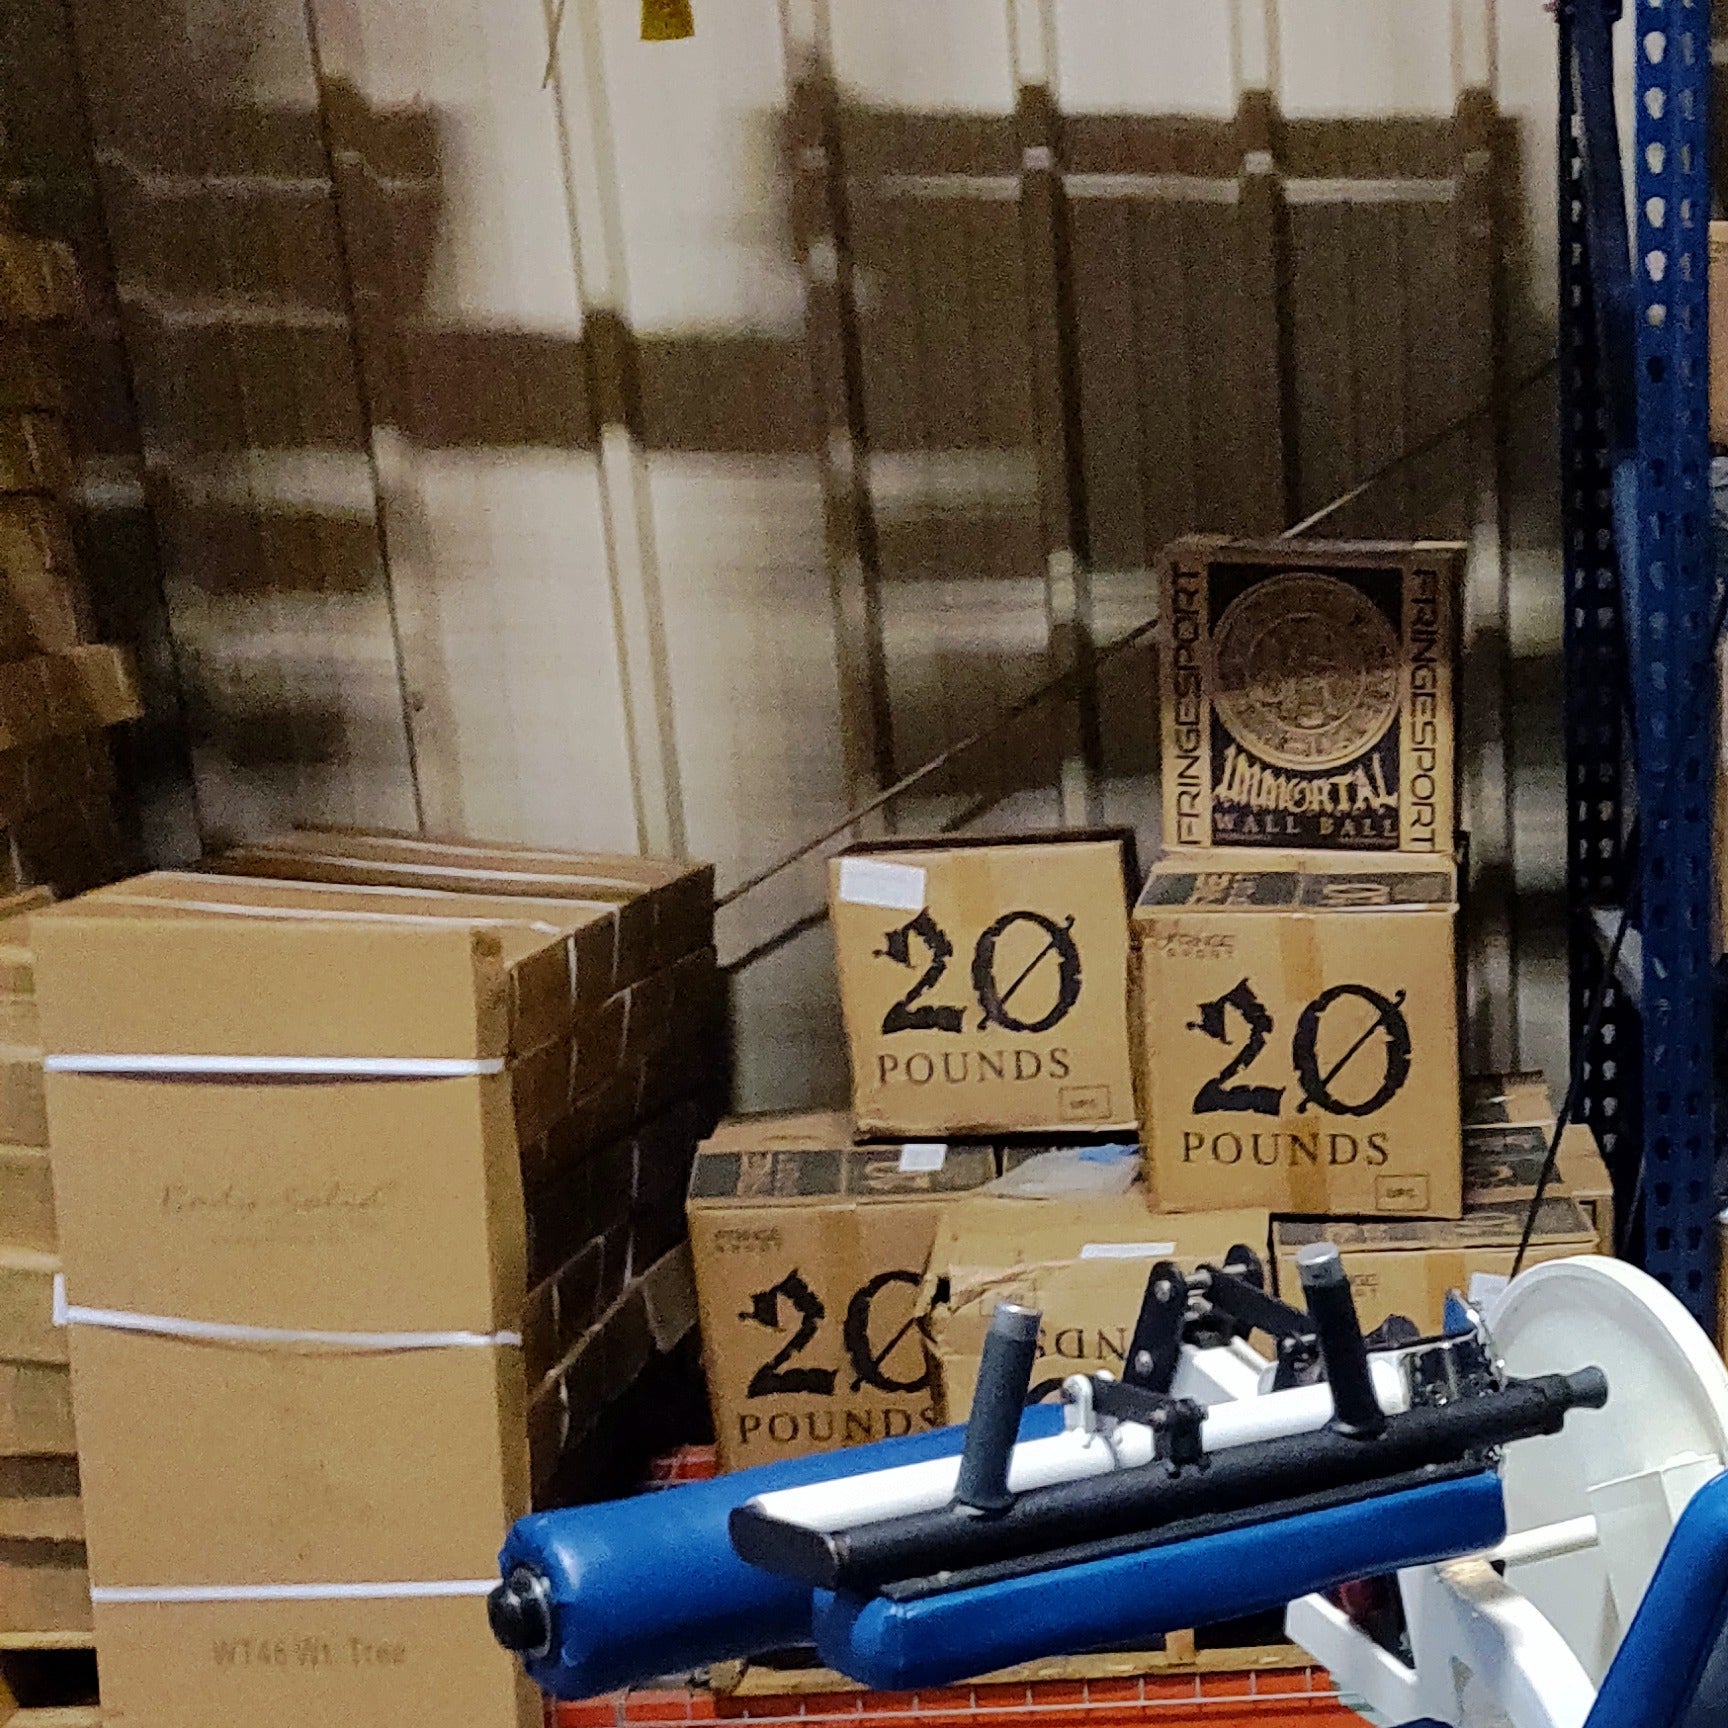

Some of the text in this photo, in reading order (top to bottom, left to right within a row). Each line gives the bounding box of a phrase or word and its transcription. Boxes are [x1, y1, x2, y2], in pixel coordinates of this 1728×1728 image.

[1172, 562, 1202, 846] FRINGESPORT
[1410, 568, 1438, 851] FRINGESPORT
[1211, 743, 1399, 814] IMMORTAL
[1214, 812, 1399, 837] WALL BALL
[872, 906, 1082, 1035] 20
[877, 1047, 1071, 1086] POUNDS
[1185, 977, 1411, 1117] 20
[1182, 1130, 1390, 1167] POUNDS
